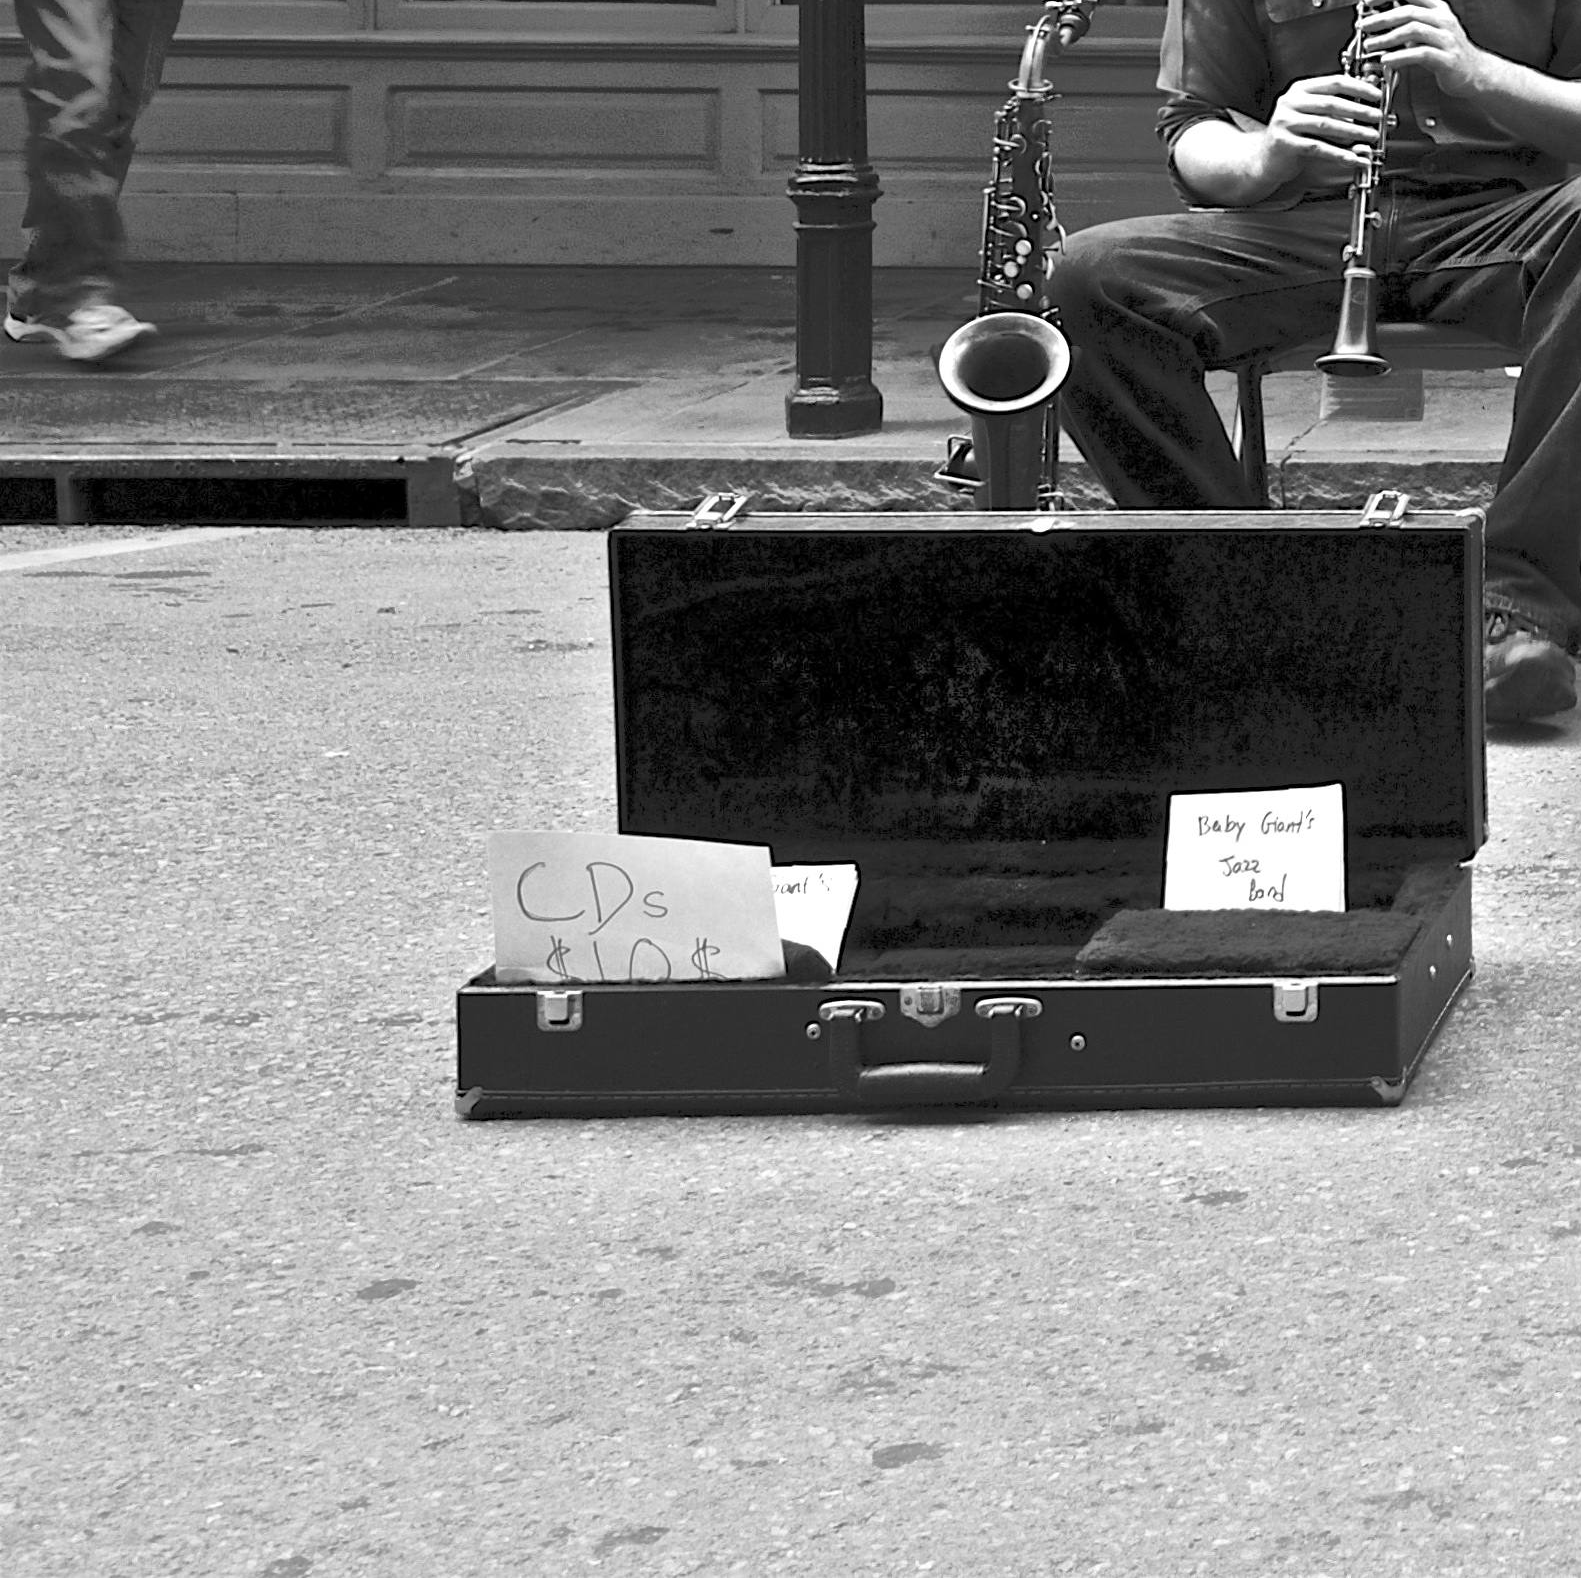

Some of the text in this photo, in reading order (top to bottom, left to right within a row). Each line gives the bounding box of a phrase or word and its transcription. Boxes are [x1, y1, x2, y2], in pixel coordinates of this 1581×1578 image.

[1197, 809, 1315, 842] Baby Giant's
[1218, 855, 1261, 877] Jazz
[516, 861, 669, 936] CDs
